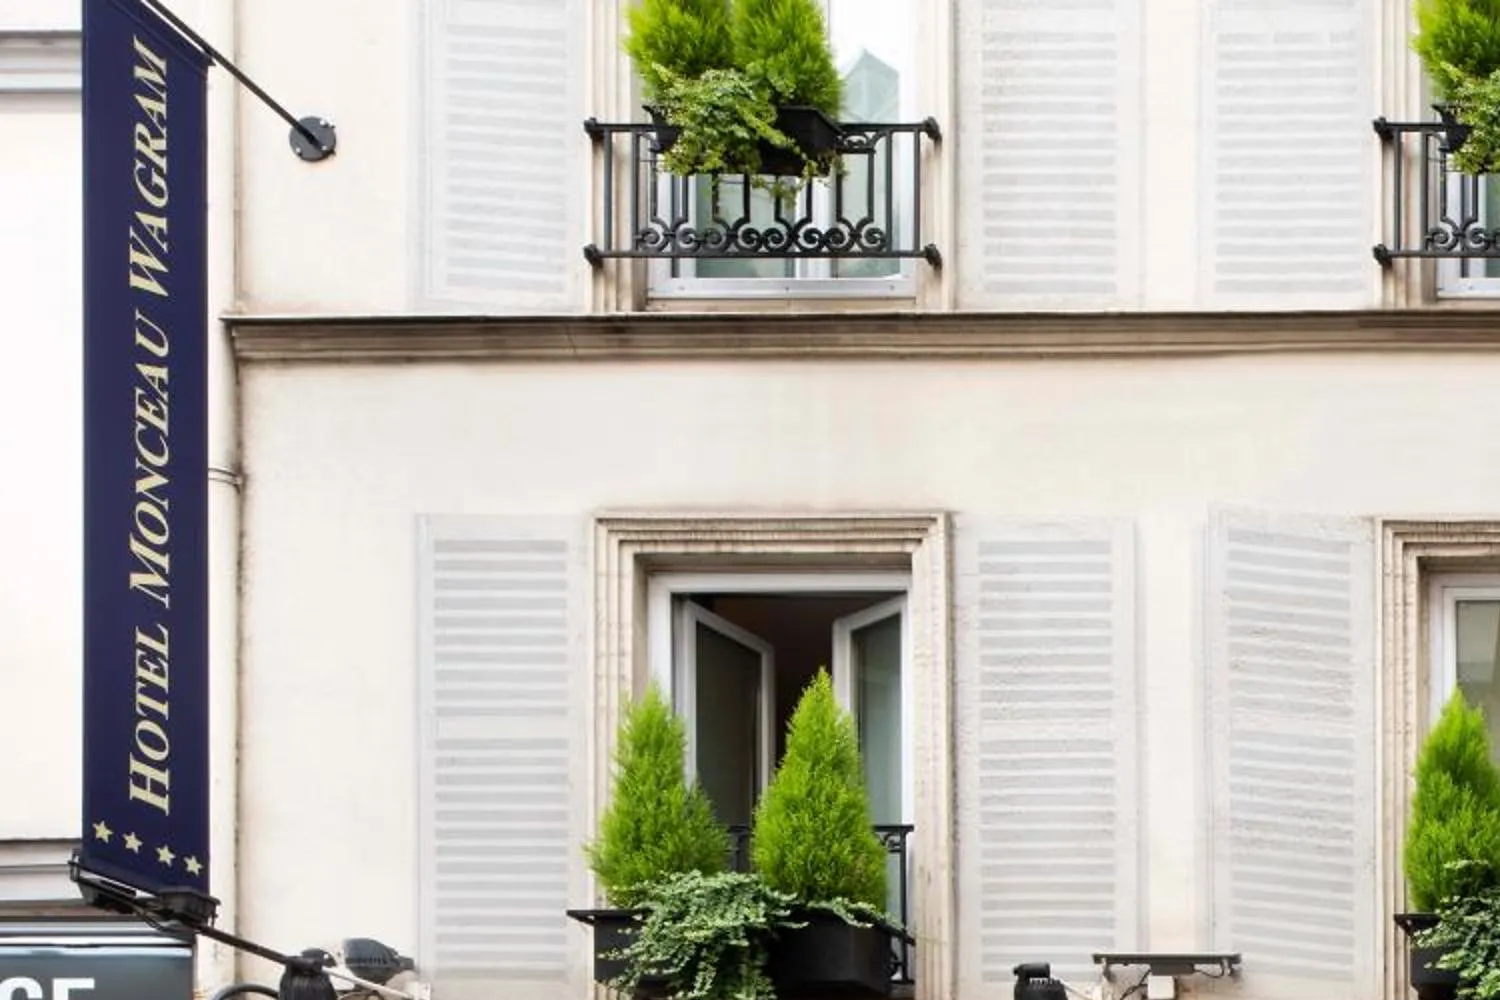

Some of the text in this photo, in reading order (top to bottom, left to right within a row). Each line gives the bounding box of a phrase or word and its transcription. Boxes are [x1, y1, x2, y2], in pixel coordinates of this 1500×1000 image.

[129, 34, 170, 817] HOTEL MONCEAU WAGRAM
